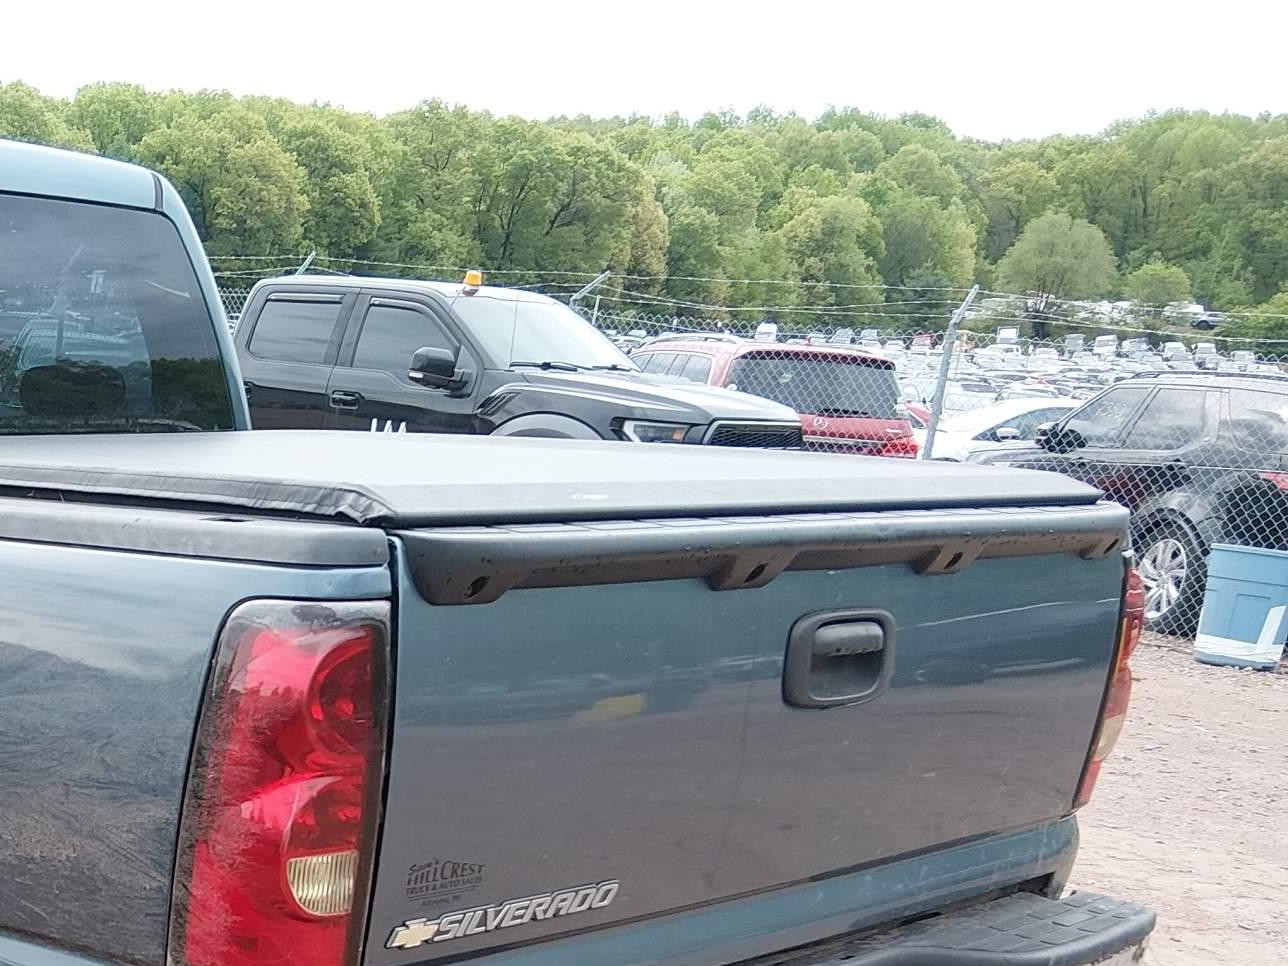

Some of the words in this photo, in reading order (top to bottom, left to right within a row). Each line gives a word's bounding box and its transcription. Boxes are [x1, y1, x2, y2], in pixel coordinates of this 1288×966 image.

[406, 884, 430, 896] TRUCK
[431, 883, 438, 891] &
[439, 880, 460, 889] AUTO
[431, 880, 621, 942] SILVERADO
